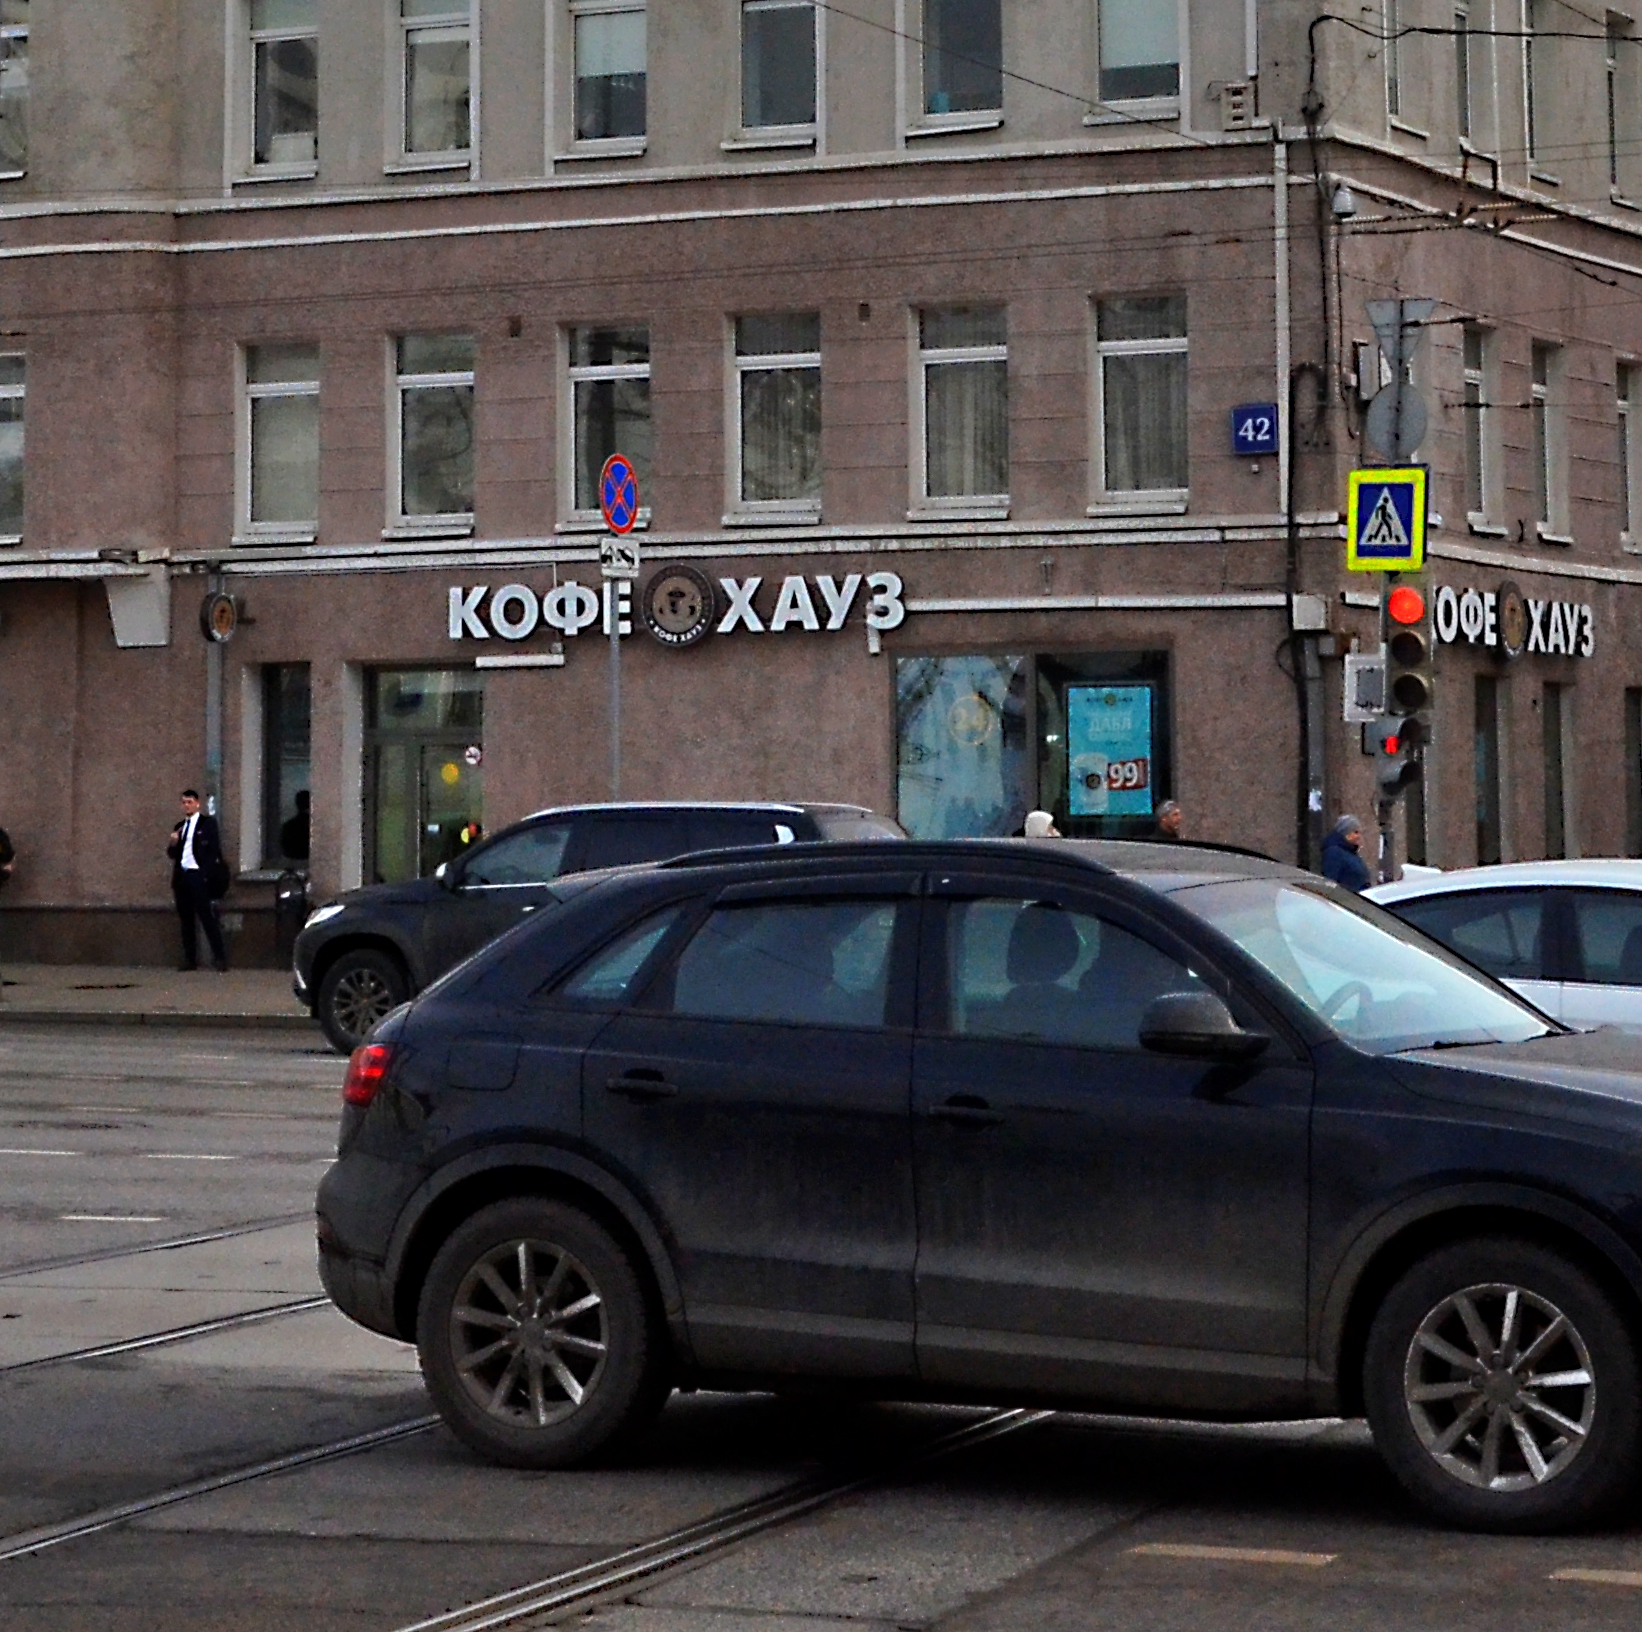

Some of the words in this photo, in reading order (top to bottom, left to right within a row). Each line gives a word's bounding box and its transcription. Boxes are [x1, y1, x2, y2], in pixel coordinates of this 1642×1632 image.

[1239, 417, 1270, 441] 42
[448, 578, 632, 640] КОФЕ
[716, 572, 905, 633] ХАУЗ
[1431, 585, 1497, 646] ОФЕ
[1527, 598, 1595, 658] ХАУЗ
